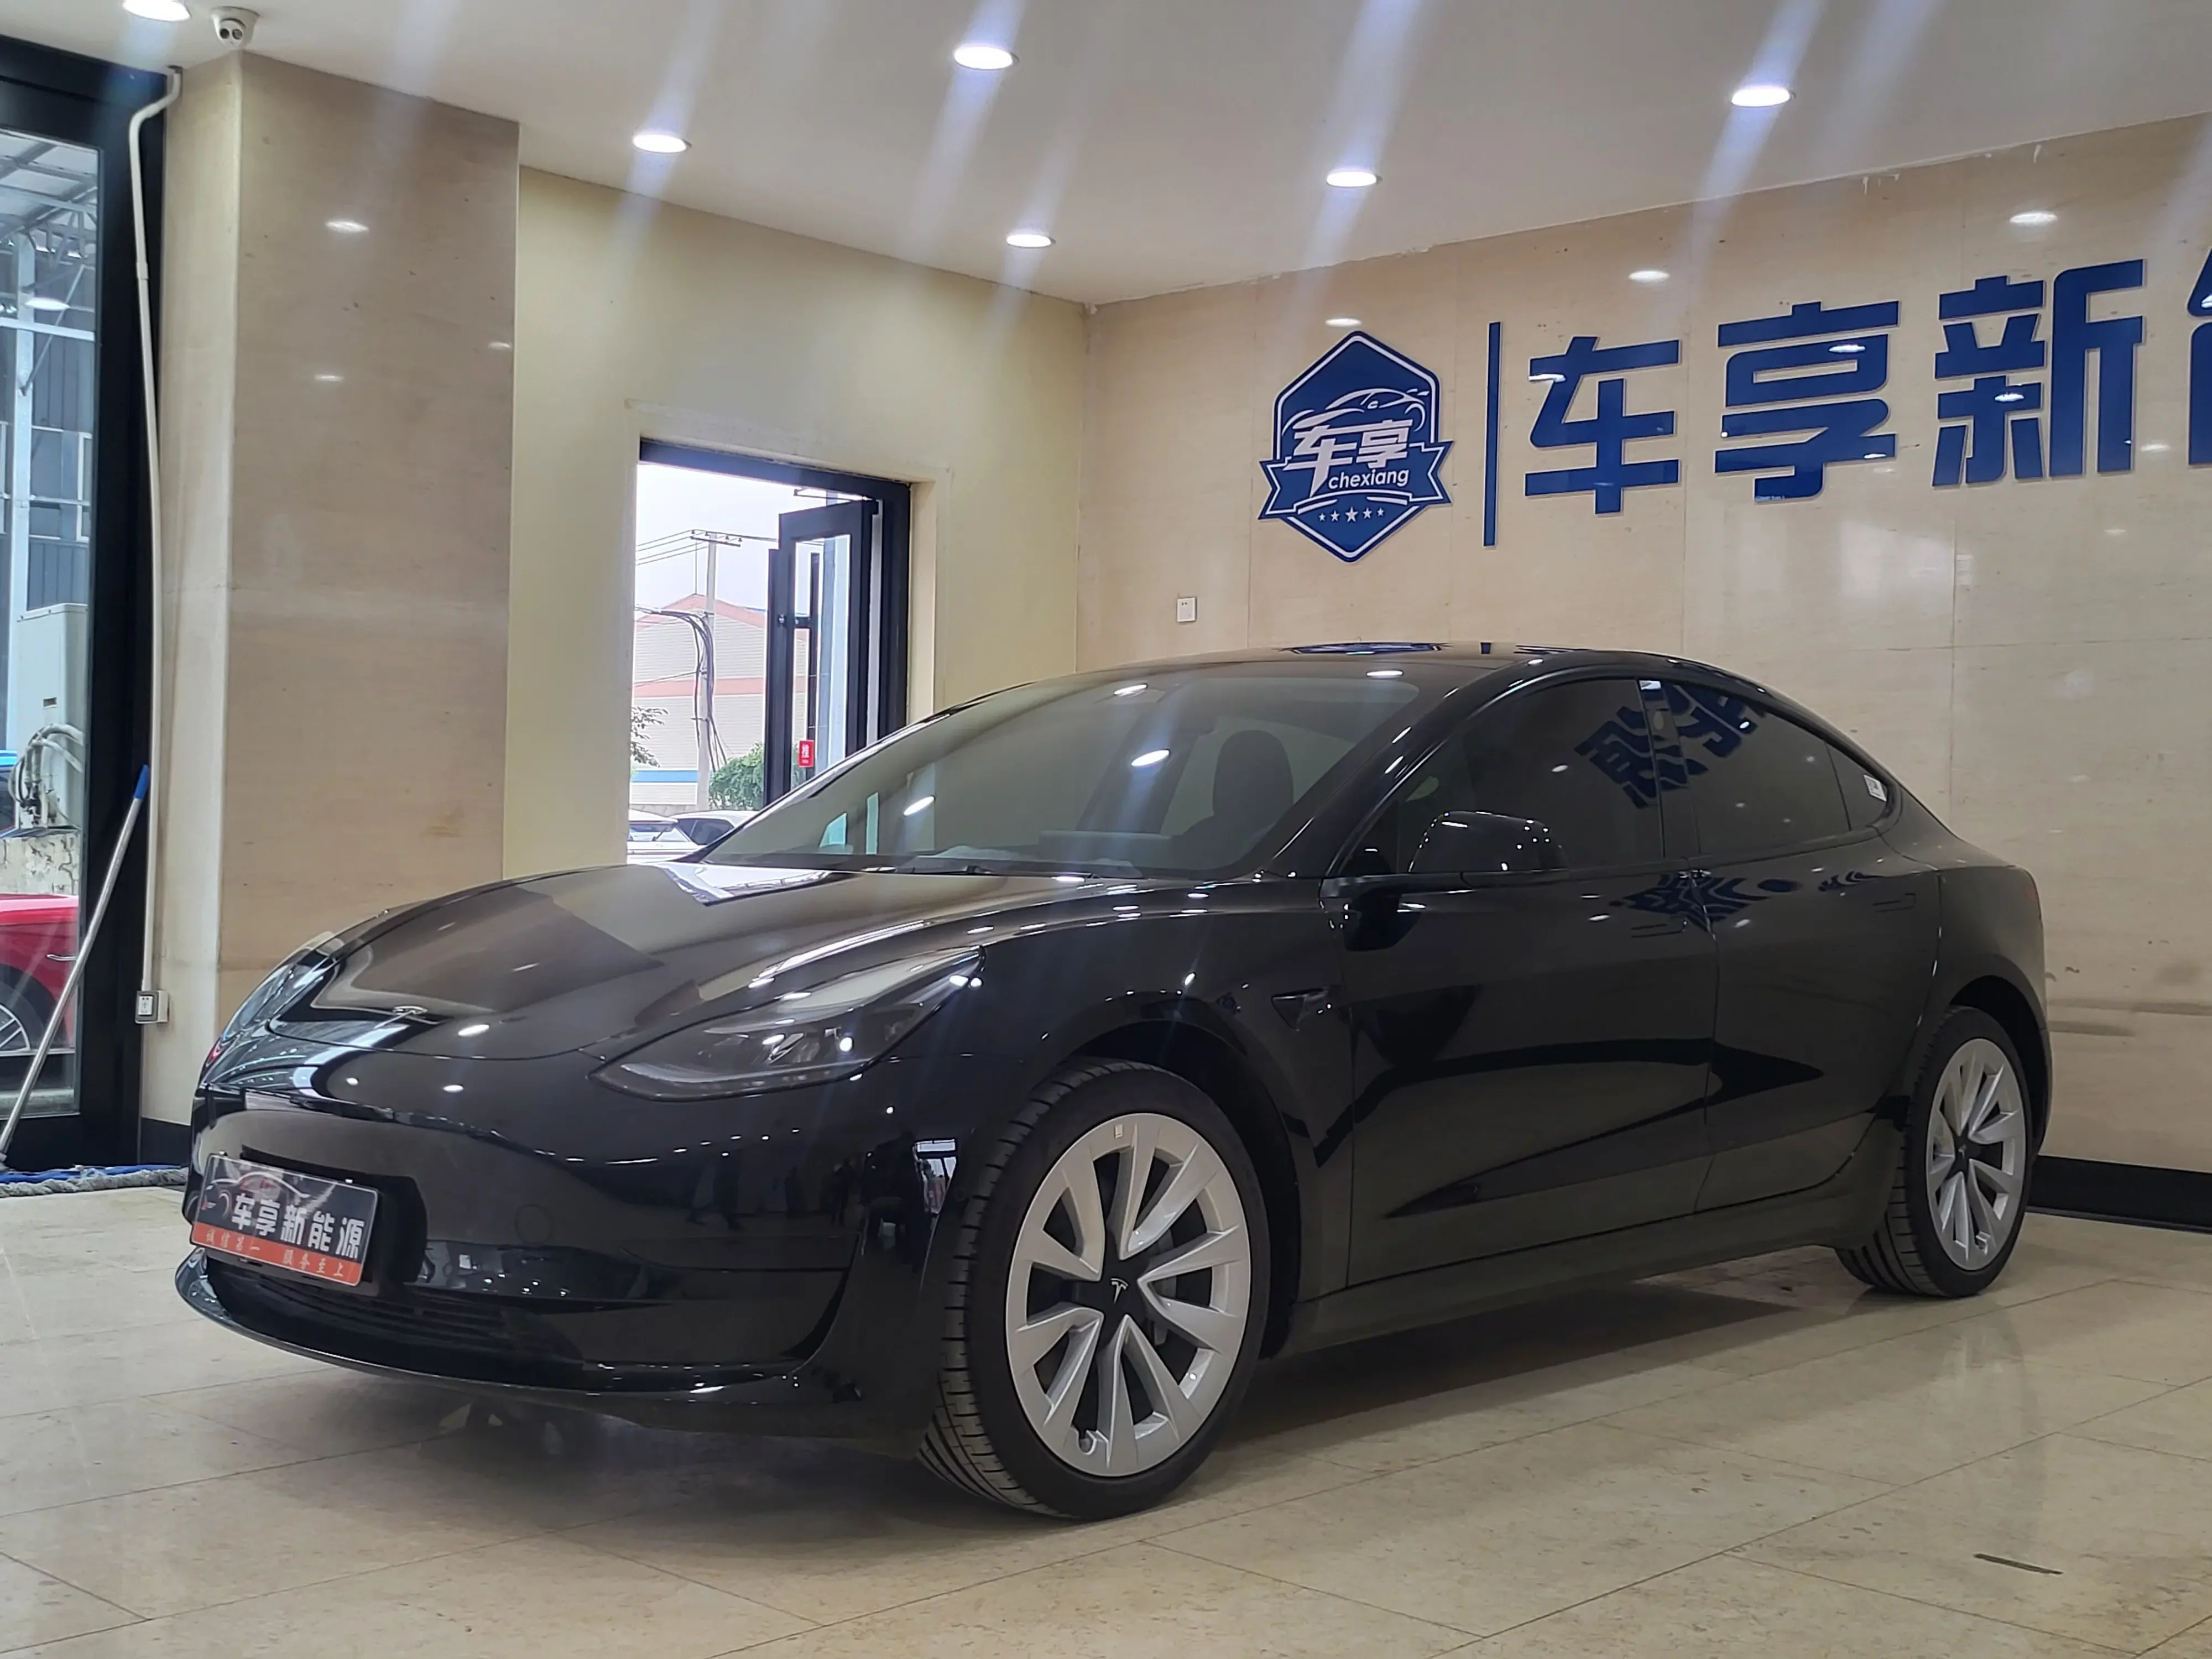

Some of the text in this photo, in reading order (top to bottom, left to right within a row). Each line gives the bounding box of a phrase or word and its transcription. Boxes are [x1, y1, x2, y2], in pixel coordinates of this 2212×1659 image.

[1525, 247, 2212, 515] 车享新
[1283, 419, 1413, 498] 车享
[1328, 469, 1410, 489] chexiang
[231, 1192, 364, 1260] 车享新能源
